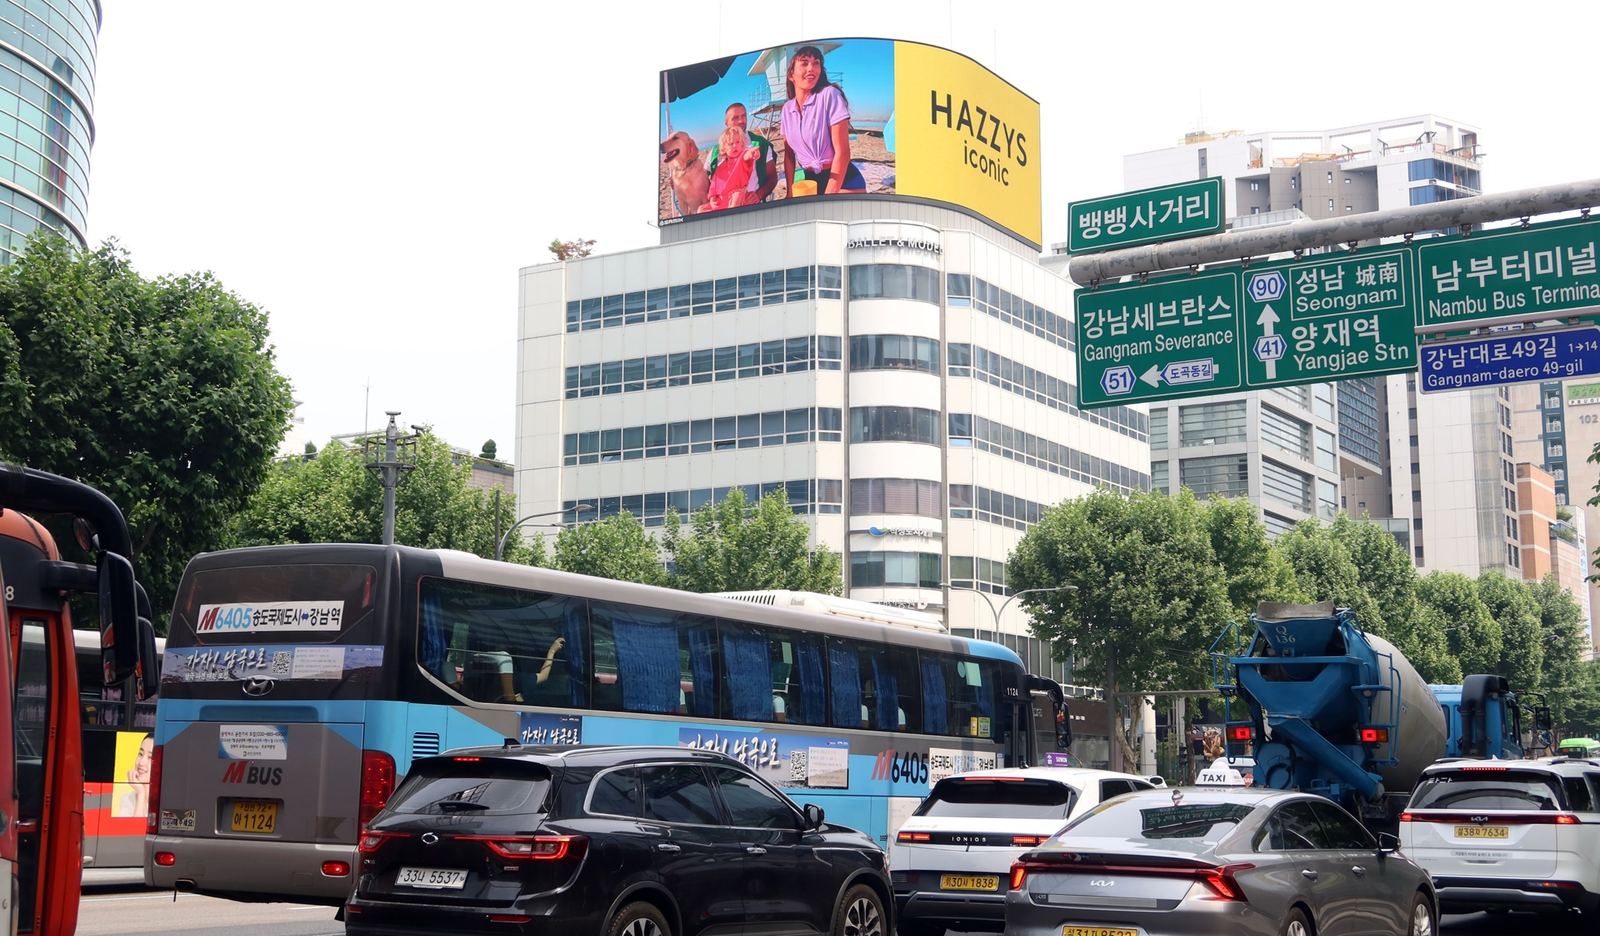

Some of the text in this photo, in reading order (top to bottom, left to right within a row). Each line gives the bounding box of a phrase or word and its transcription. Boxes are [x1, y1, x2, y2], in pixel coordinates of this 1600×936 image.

[931, 90, 1027, 166] HAZZYS
[964, 140, 1008, 186] iconic
[1080, 192, 1209, 239] 뱅뱅사거리
[848, 240, 893, 248] BALLET
[1296, 262, 1398, 294] 성남 城南
[1432, 242, 1596, 293] 남부터미널
[1256, 277, 1278, 296] 90
[1296, 288, 1397, 312] Seongnam
[1429, 296, 1487, 318] Nambu
[1493, 292, 1526, 310] Bus
[1083, 296, 1232, 338] 강남세브란스
[1292, 315, 1380, 352] 양재역
[1084, 330, 1233, 362] Gangnam Severance
[1261, 340, 1279, 356] 41
[1294, 344, 1408, 371] Yangjae Stn
[1427, 336, 1557, 370] 강남대로49길
[1108, 372, 1127, 390] 51
[1170, 364, 1211, 380] 도곡동길
[1427, 359, 1583, 387] Gangnam-daero 49-gil
[1579, 414, 1599, 424] 102
[252, 608, 301, 627] 송도국제도시
[310, 608, 341, 626] 강남역
[186, 648, 267, 671] 가자! 남극으로
[1007, 688, 1019, 696] 1124
[522, 726, 580, 745] 가자! 남극으로
[734, 737, 780, 769] 남극으로
[247, 766, 282, 786] BUS
[1202, 774, 1226, 782] TAXI
[1482, 828, 1505, 837] 7634
[429, 871, 460, 884] 5537
[971, 878, 994, 888] 1838
